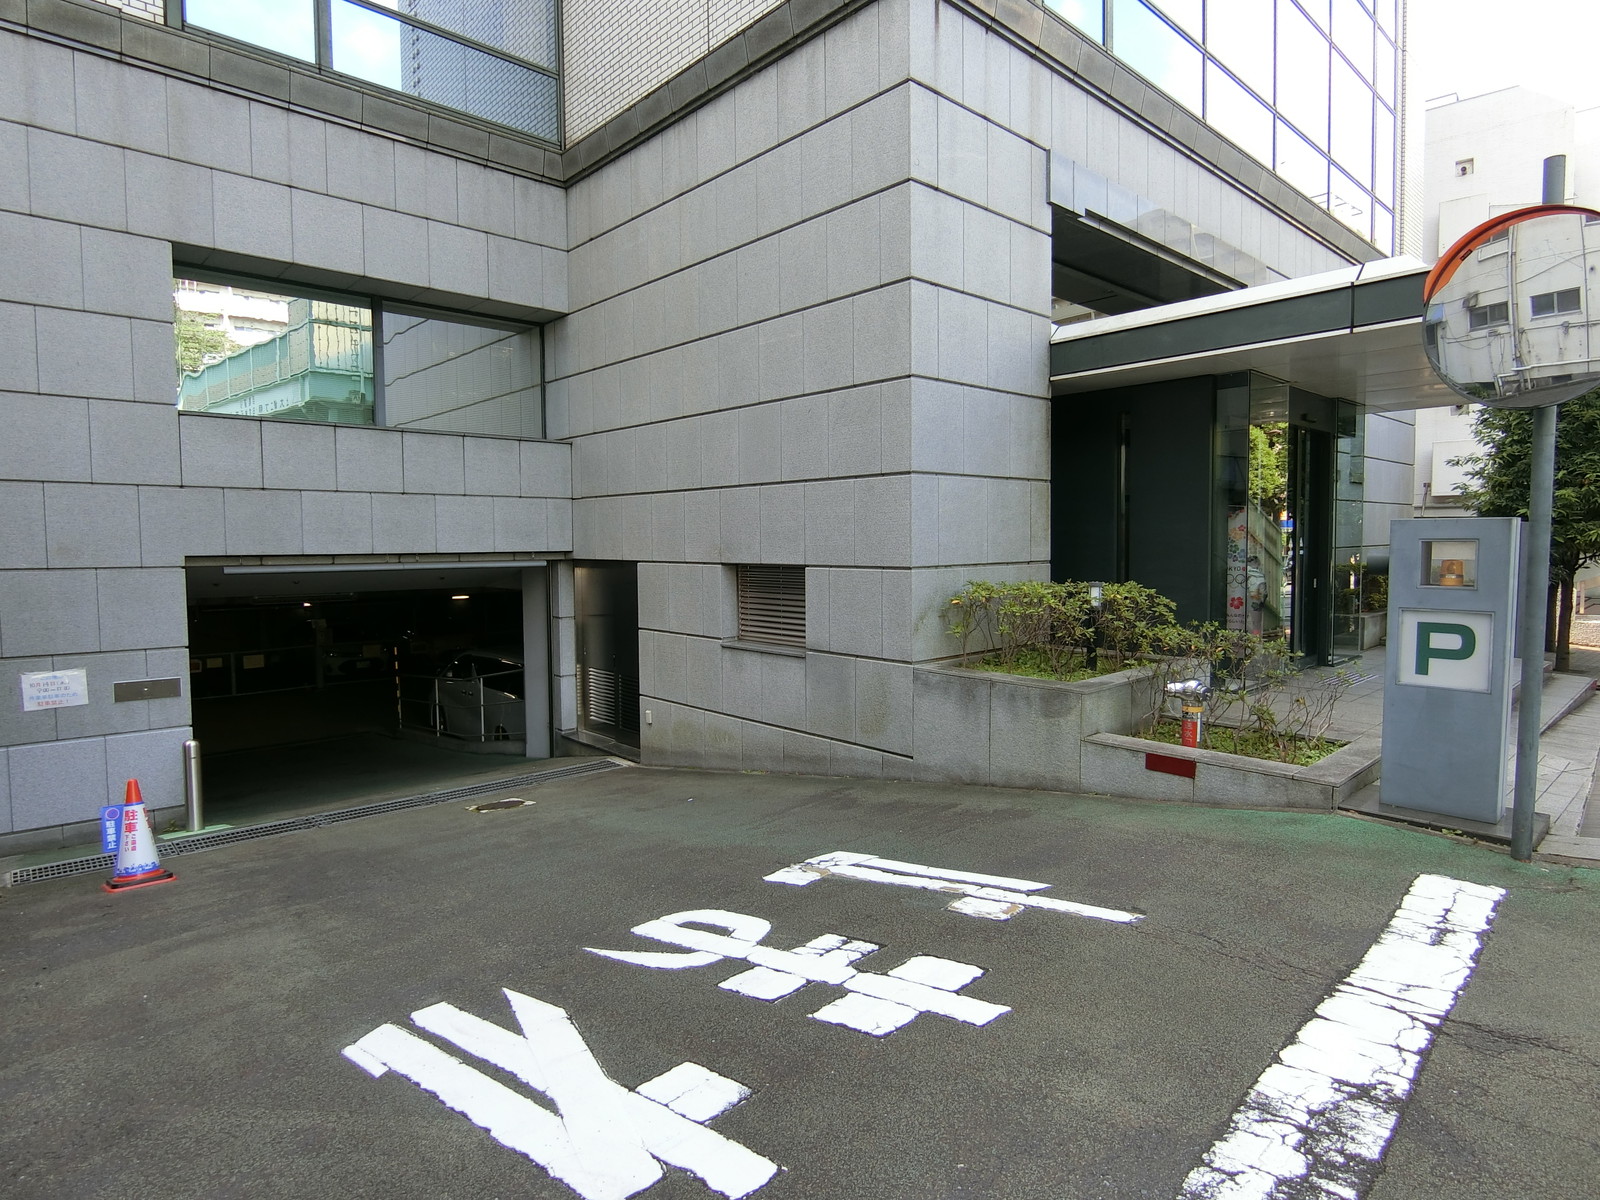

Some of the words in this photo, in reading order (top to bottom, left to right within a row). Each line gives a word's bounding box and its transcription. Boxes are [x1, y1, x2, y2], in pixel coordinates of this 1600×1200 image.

[1414, 621, 1477, 676] P
[106, 821, 117, 849] 駐車禁止
[124, 809, 138, 833] 駐車
[340, 849, 1147, 1200] 止まれ
